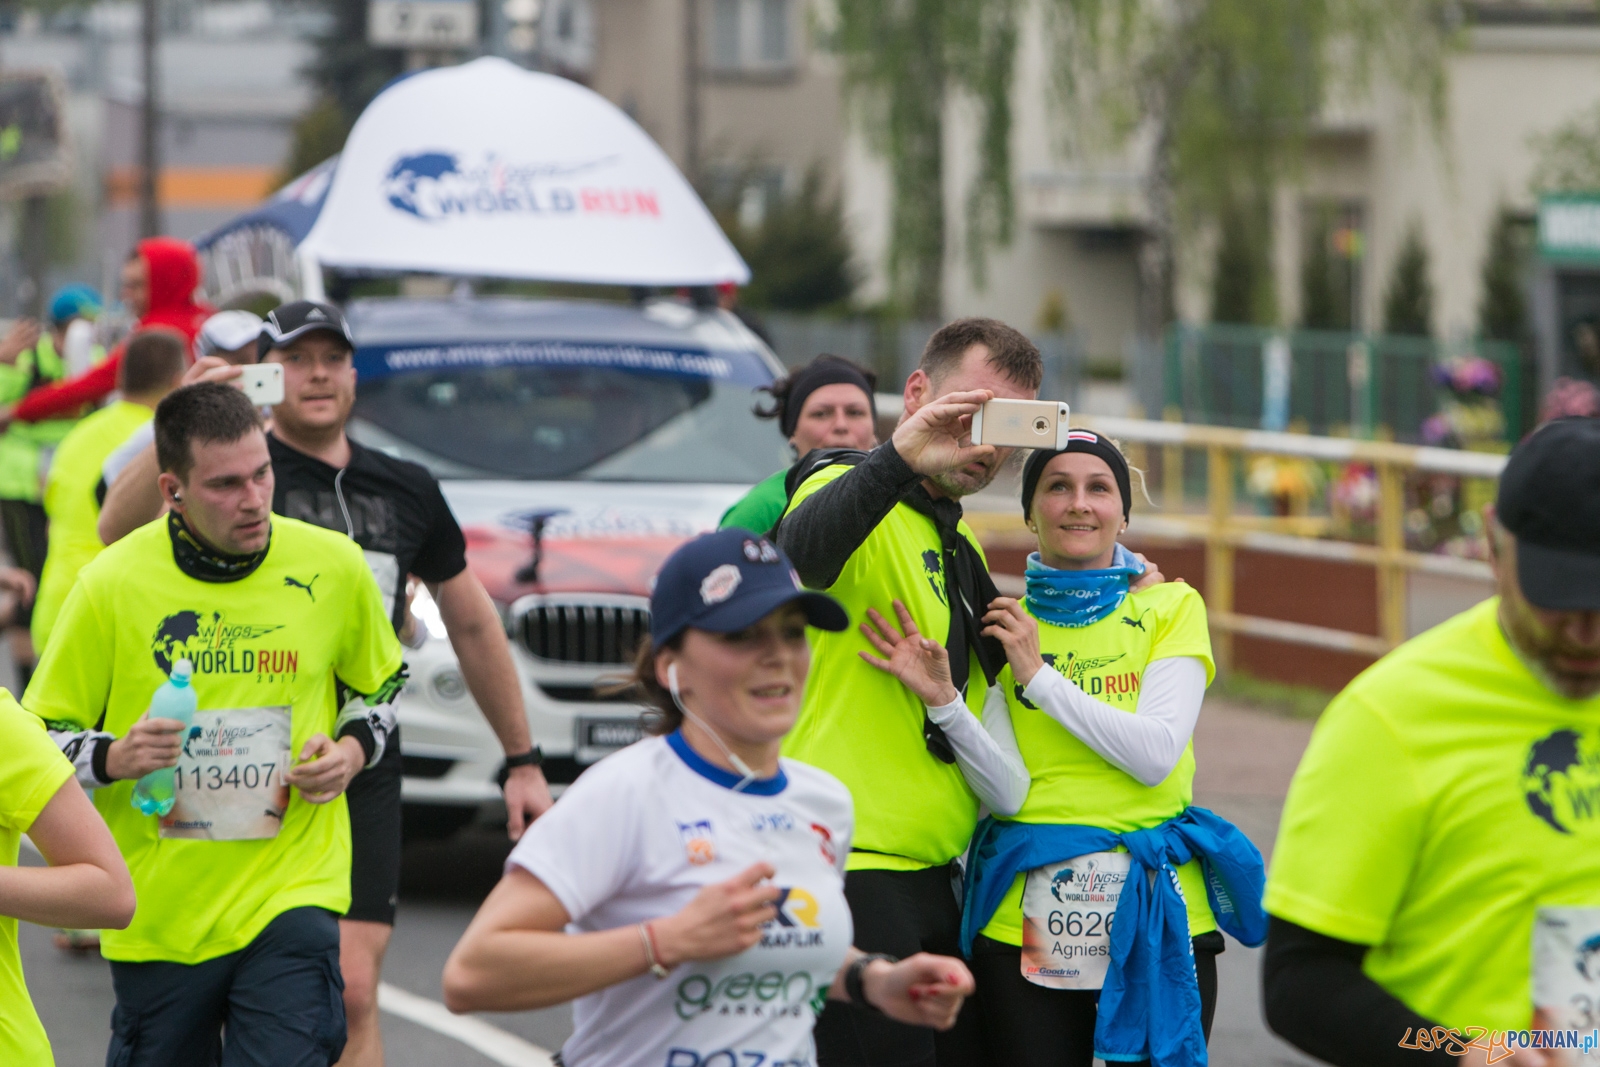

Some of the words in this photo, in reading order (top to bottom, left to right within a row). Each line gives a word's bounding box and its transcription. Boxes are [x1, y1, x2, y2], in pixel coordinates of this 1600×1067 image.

[579, 188, 661, 217] RUN
[200, 624, 252, 638] WINGS
[258, 650, 298, 674] RUN
[257, 674, 296, 684] 2017
[1106, 692, 1140, 702] 201
[174, 763, 276, 790] 113407
[1077, 872, 1120, 883] WINGS
[1082, 883, 1107, 893] LIFE
[1065, 893, 1090, 901] WORLD
[1090, 893, 1104, 902] RUN
[1026, 966, 1080, 977] BFGoodrich
